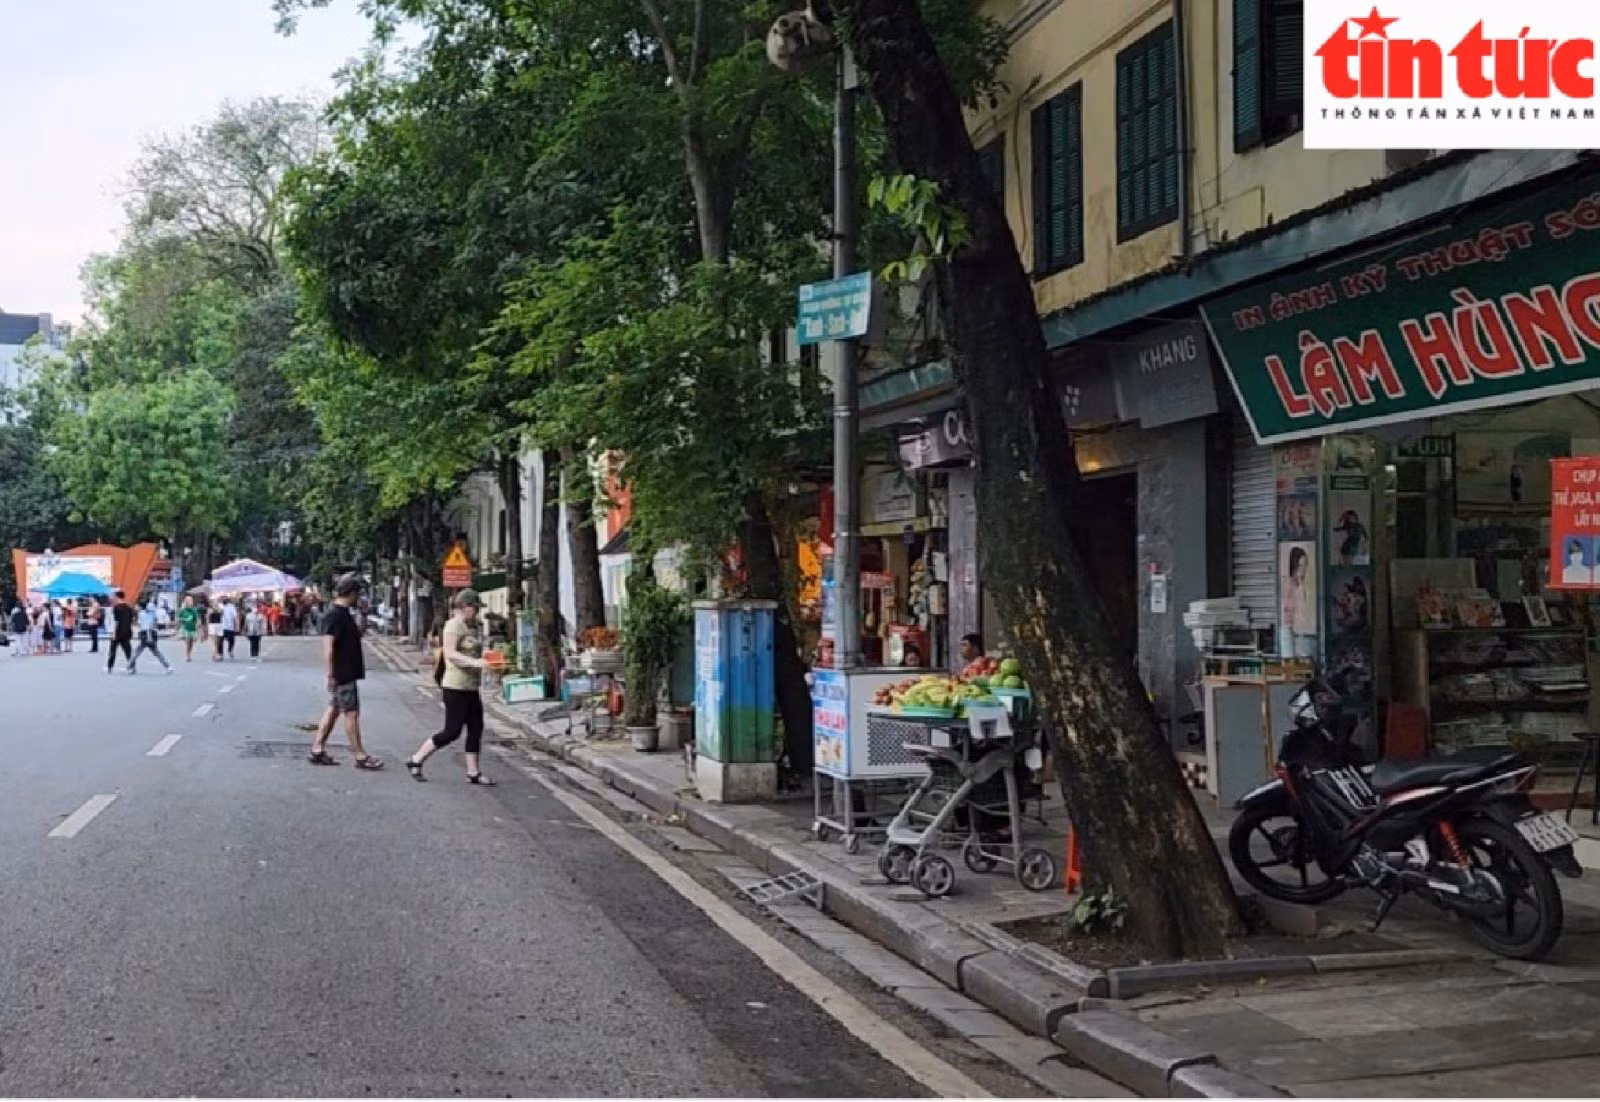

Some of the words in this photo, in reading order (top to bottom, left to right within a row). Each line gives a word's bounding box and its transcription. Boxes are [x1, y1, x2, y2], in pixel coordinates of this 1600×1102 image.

[1232, 305, 1266, 331] IN
[1396, 220, 1535, 280] THUẬT
[1138, 335, 1197, 375] KHANG
[1265, 329, 1406, 419] LÂM
